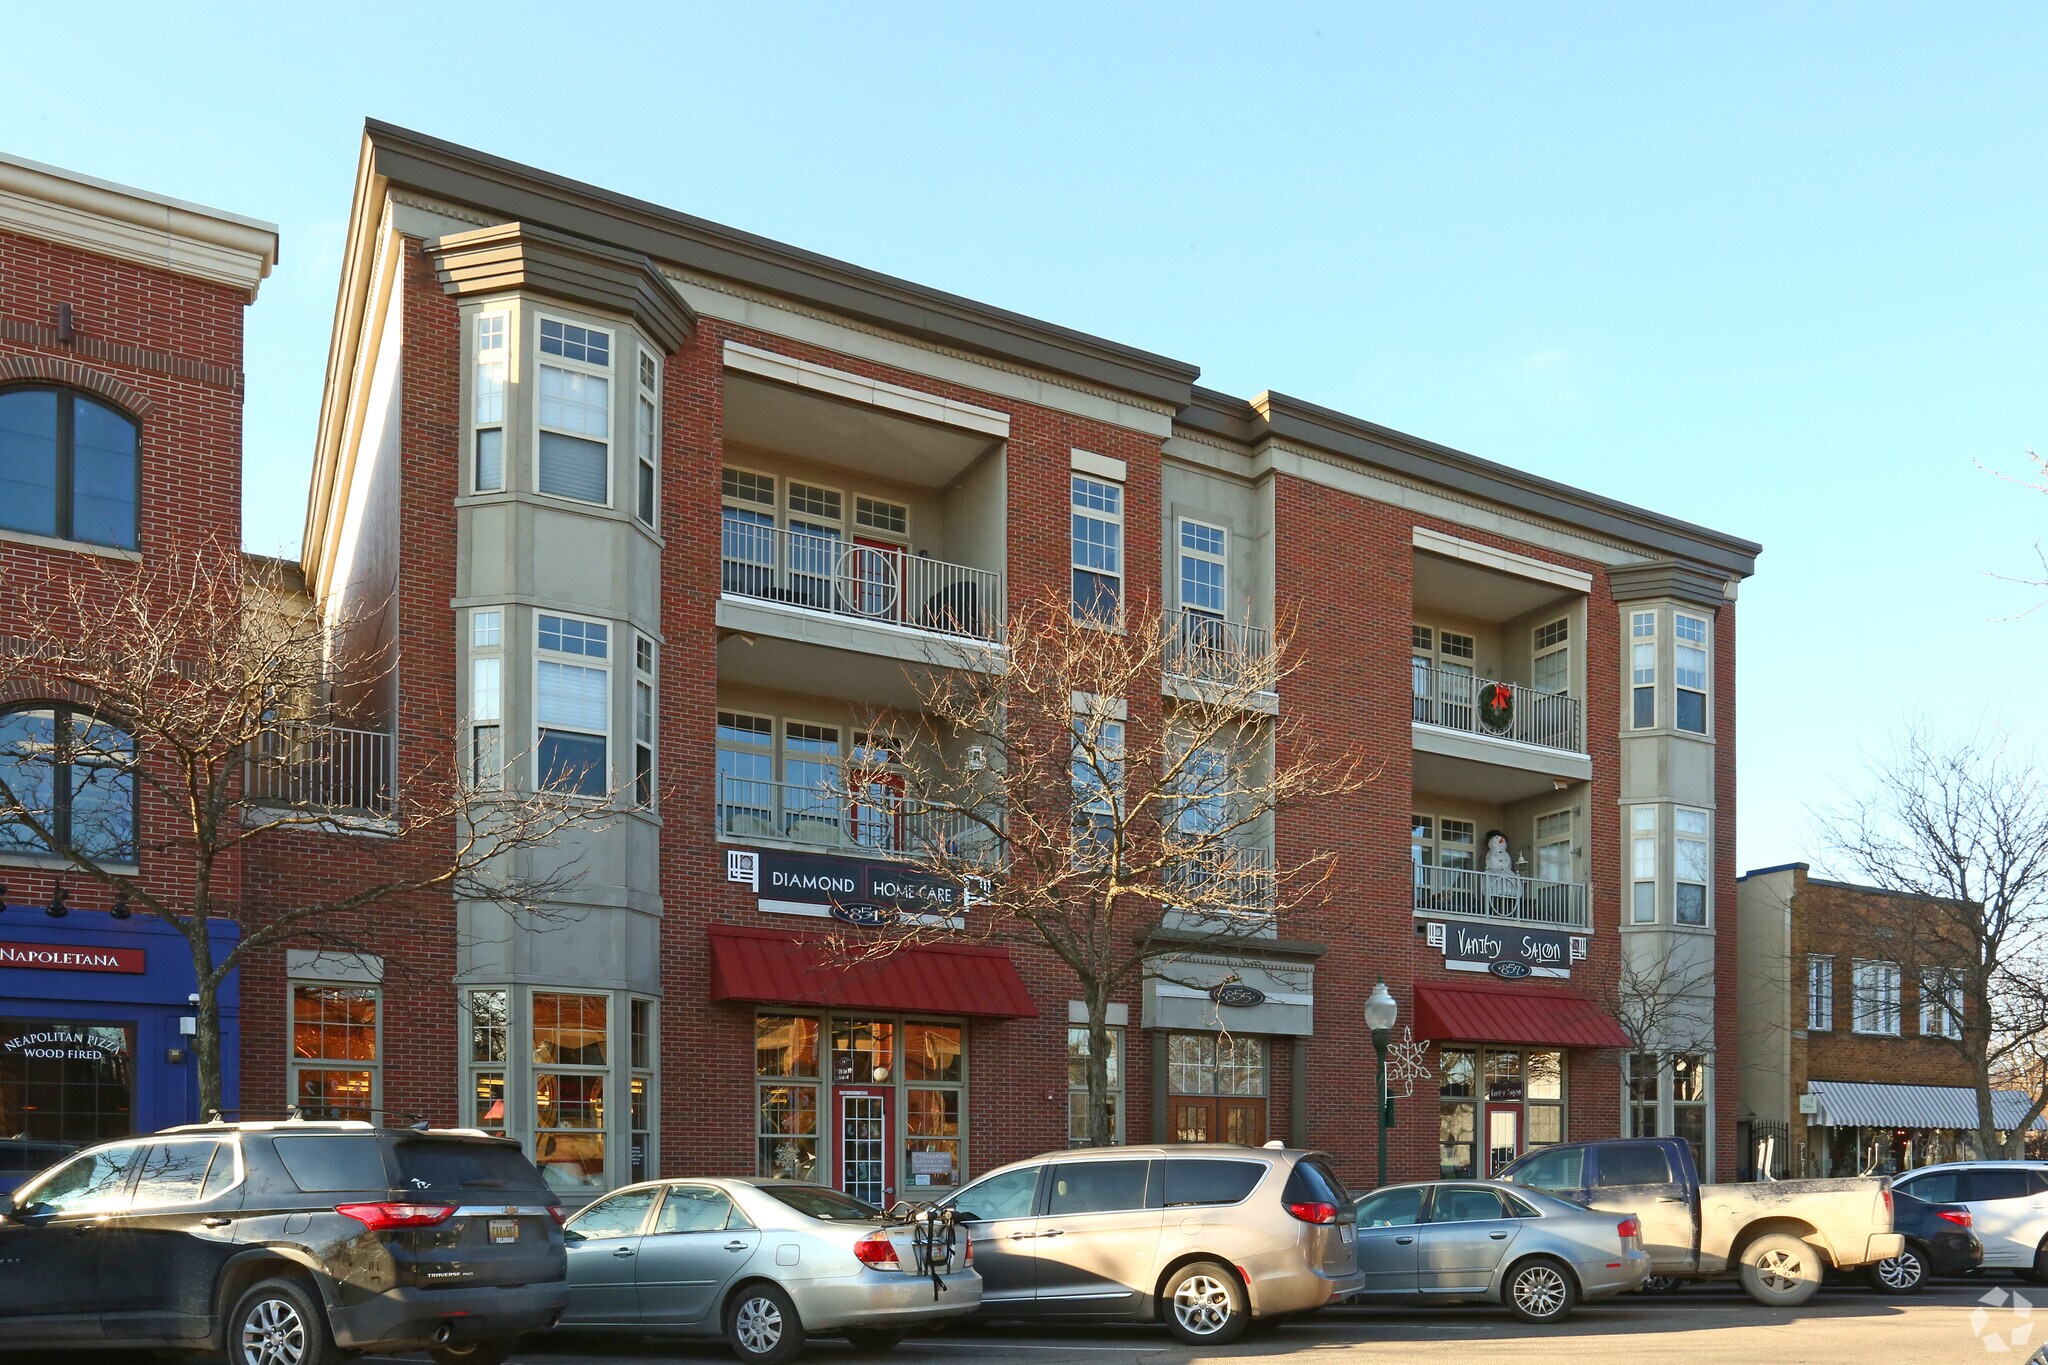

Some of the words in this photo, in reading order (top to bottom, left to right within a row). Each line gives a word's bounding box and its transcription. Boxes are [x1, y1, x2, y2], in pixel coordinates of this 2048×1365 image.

[772, 871, 855, 893] DIAMOND
[873, 881, 915, 899] HOME
[918, 884, 952, 903] CARE
[850, 906, 881, 922] 851
[0, 947, 120, 967] NAPOLETANA
[1500, 963, 1521, 976] 857
[1225, 989, 1252, 1004] 855
[4, 1031, 83, 1052] NEAPOLITAN
[87, 1034, 121, 1056] PIZZA
[24, 1048, 65, 1058] WOOD
[68, 1049, 102, 1060] FIRED
